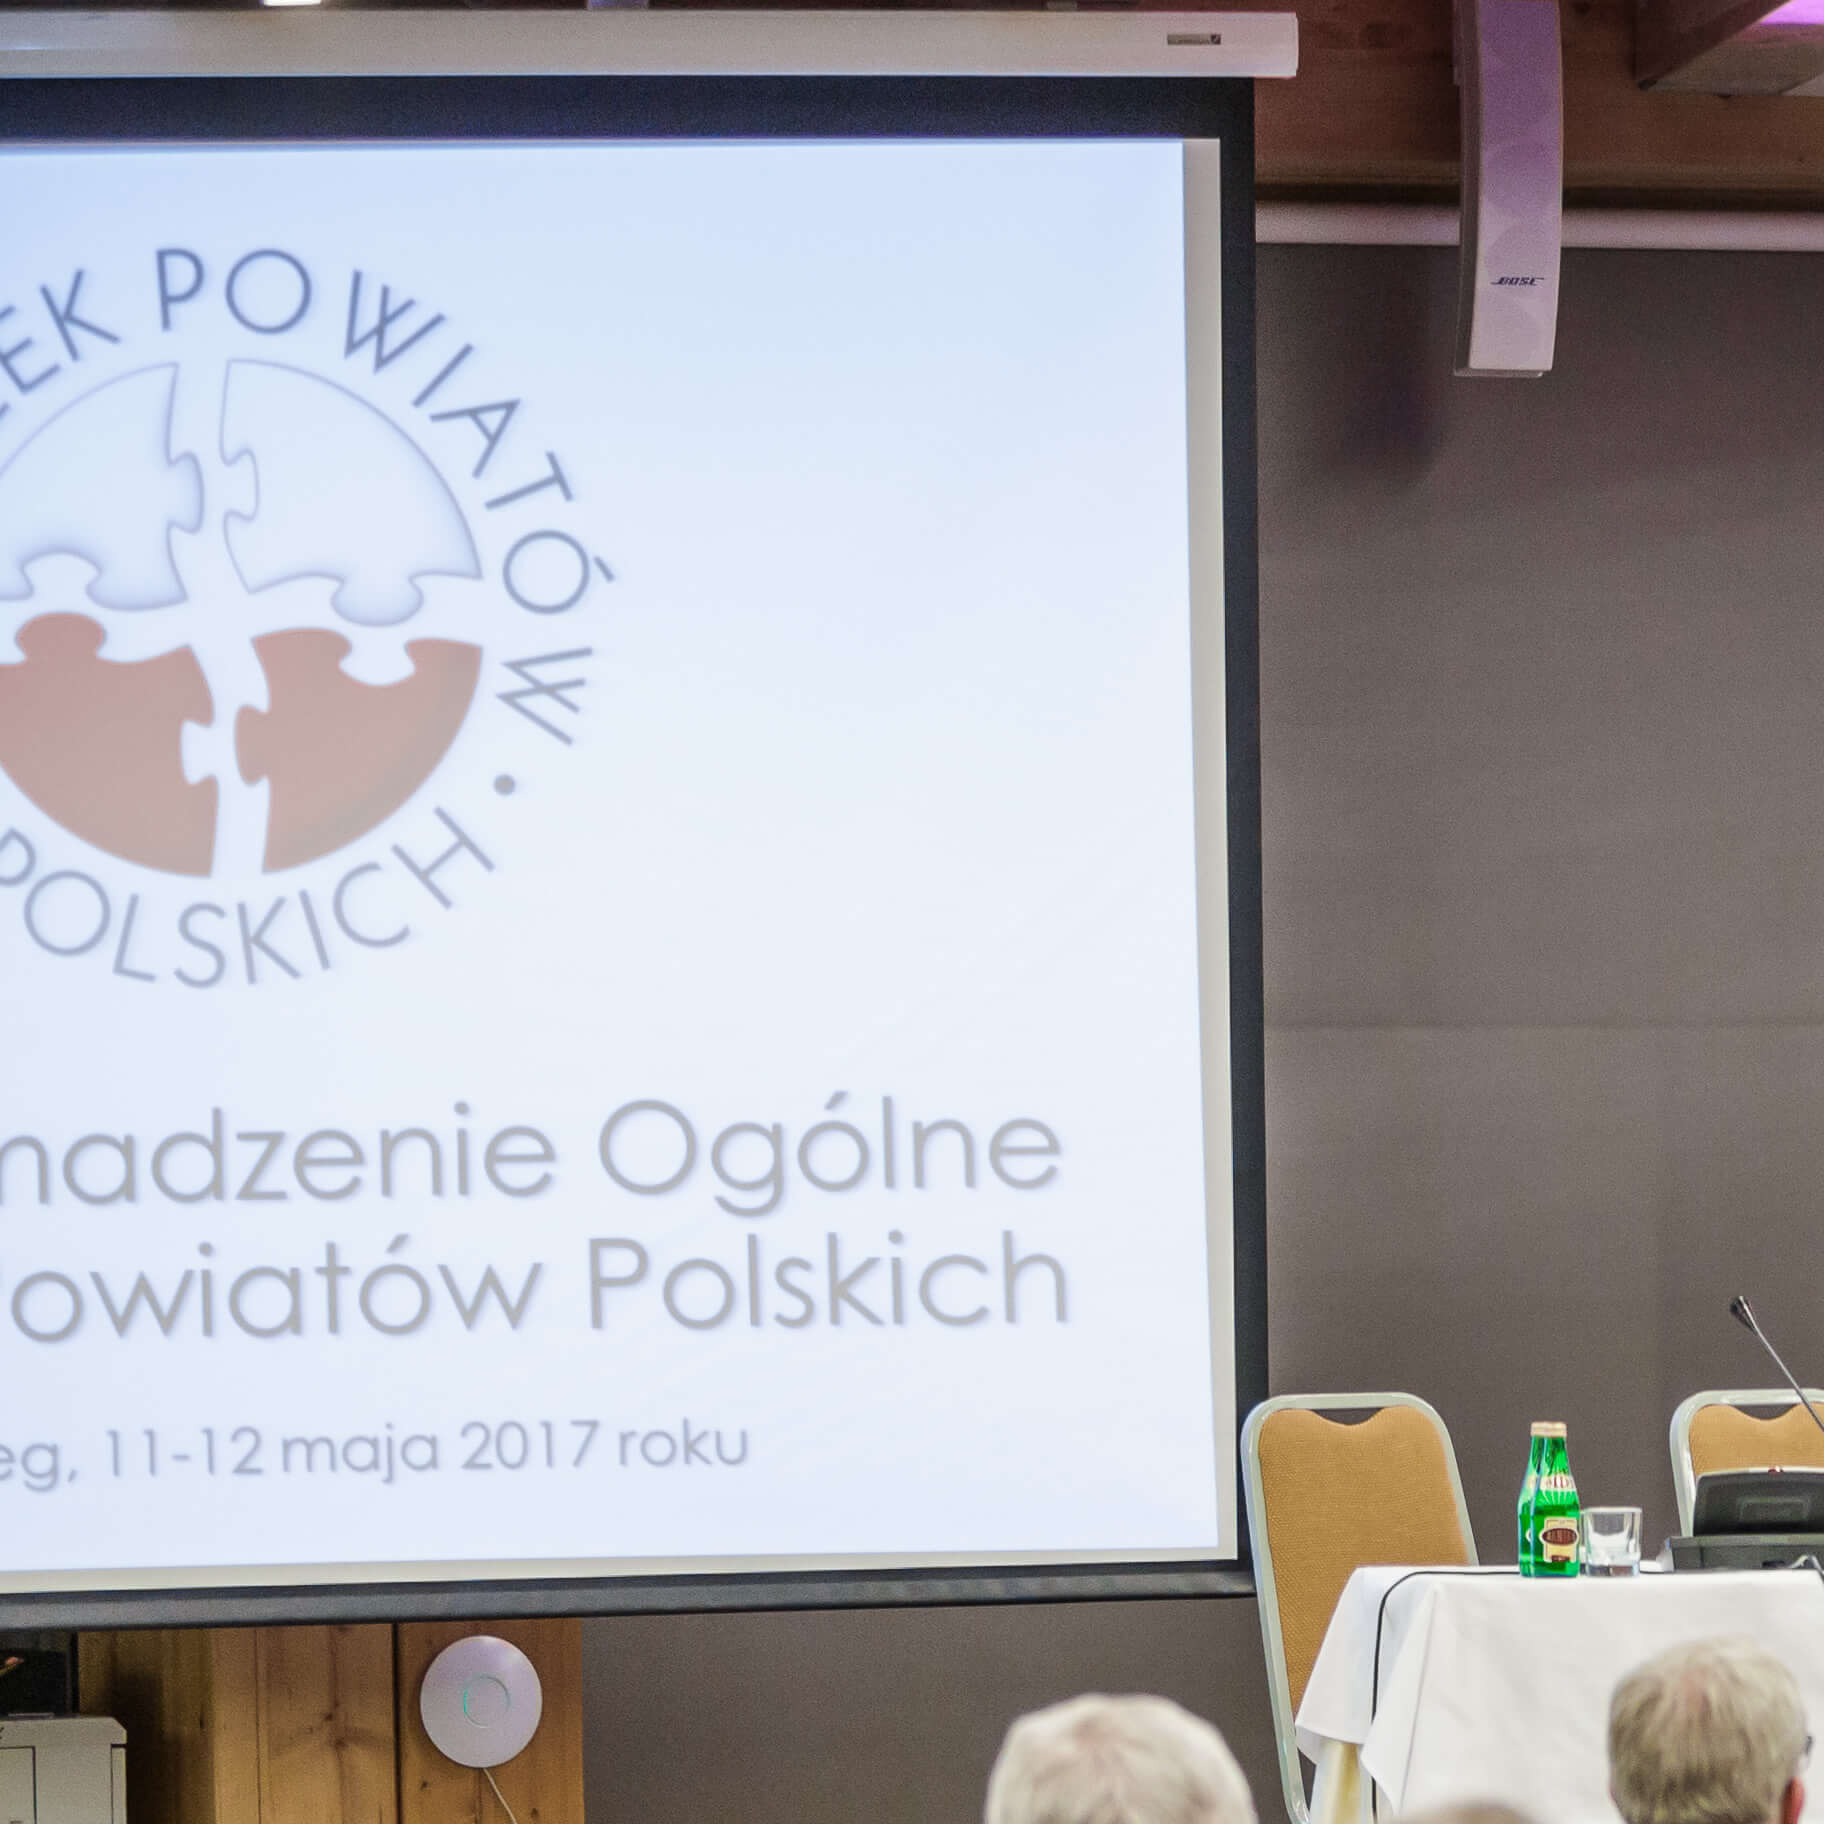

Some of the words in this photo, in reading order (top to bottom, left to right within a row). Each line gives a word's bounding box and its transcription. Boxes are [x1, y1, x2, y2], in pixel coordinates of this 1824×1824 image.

[156, 248, 616, 747] POWIATÓW
[598, 1090, 1062, 1218] Ogólne
[589, 1229, 1069, 1331] Polskich
[106, 1425, 265, 1478] 11-12
[281, 1422, 440, 1485] maja
[460, 1419, 601, 1471] 2017
[618, 1417, 750, 1468] roku
